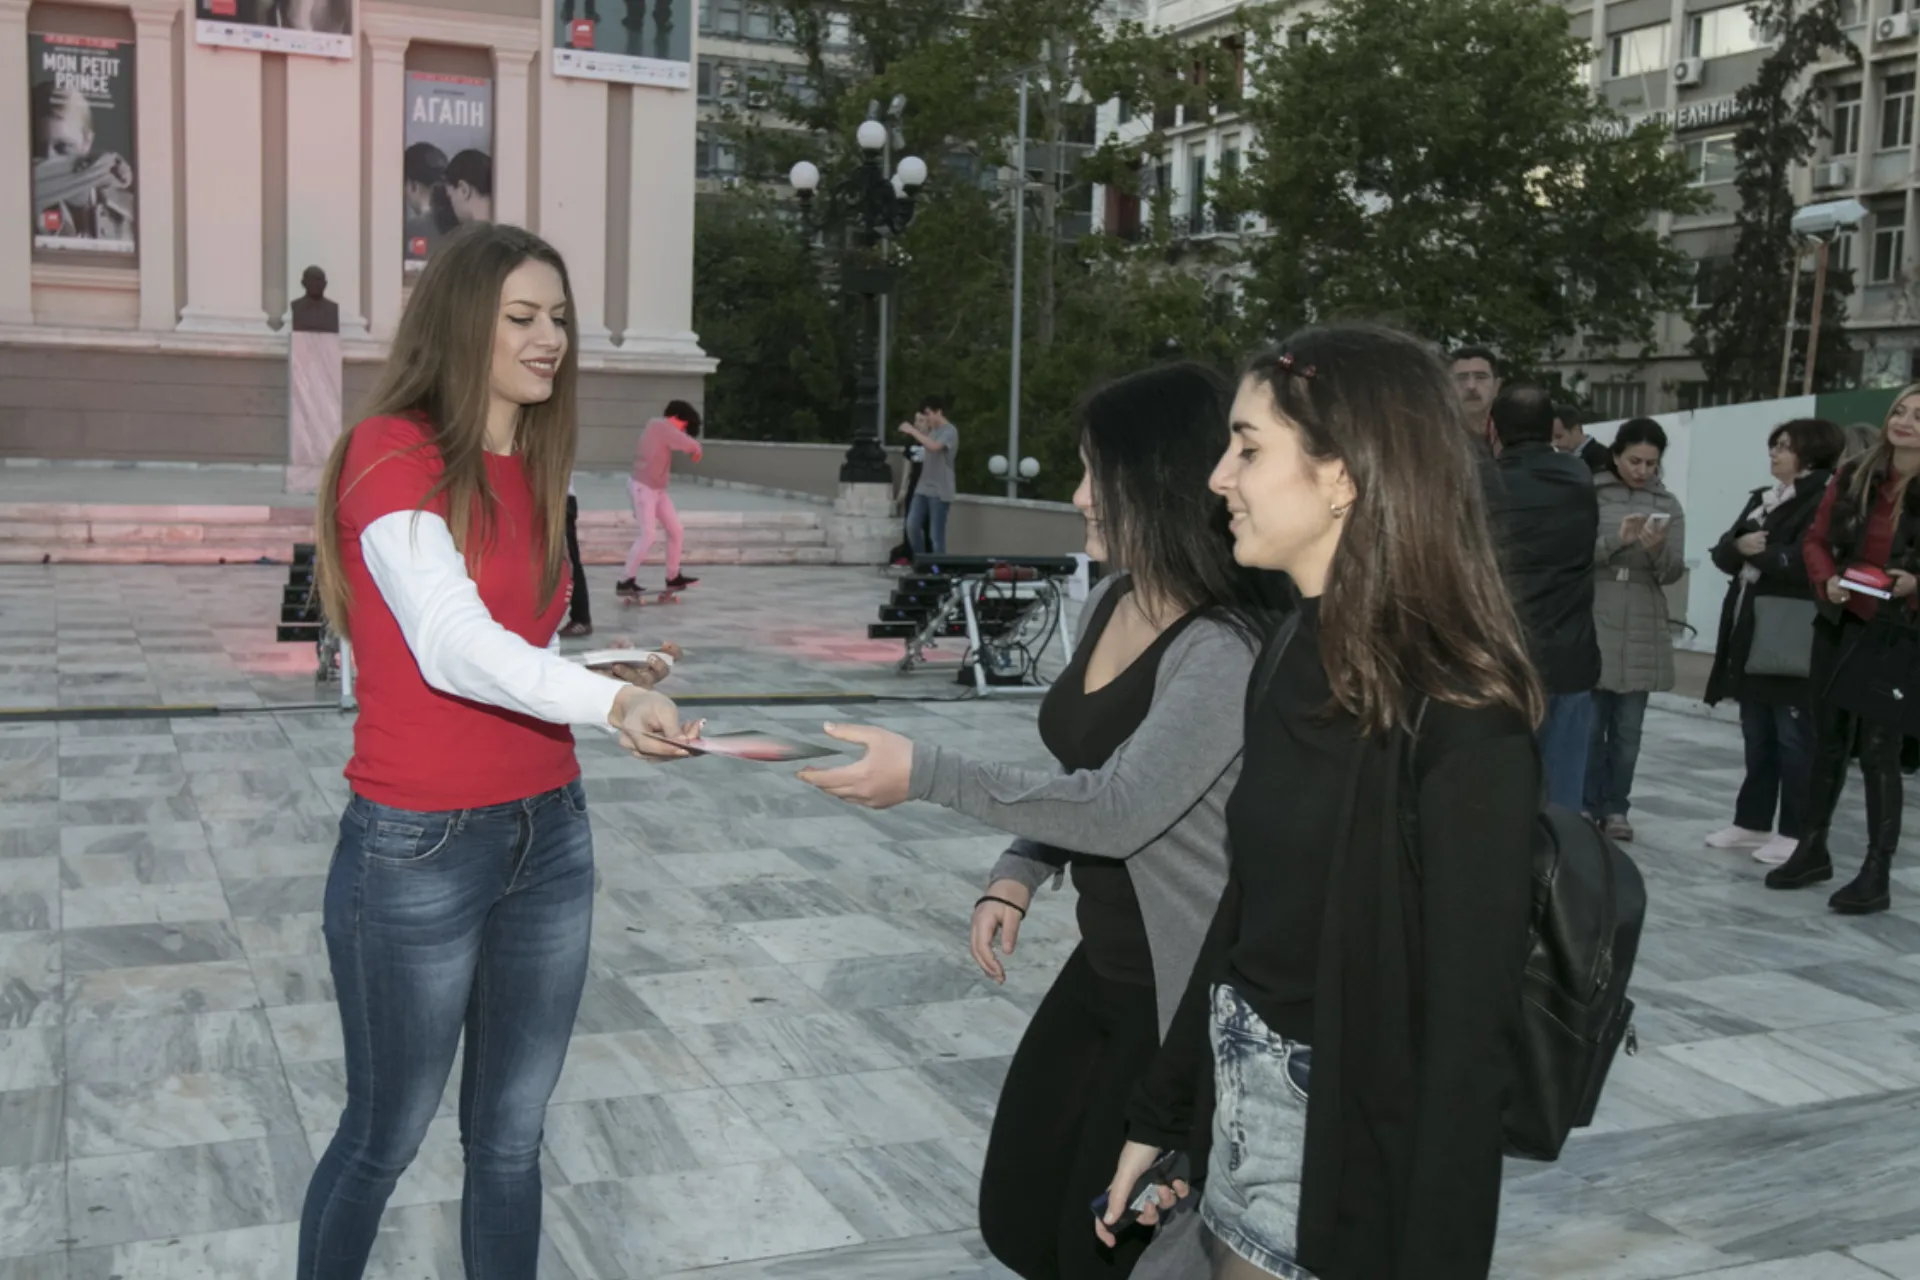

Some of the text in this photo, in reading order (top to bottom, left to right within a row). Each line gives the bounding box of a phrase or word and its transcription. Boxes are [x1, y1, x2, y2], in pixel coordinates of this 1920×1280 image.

[43, 52, 120, 77] MON PETIT
[55, 72, 109, 93] PRINCE
[412, 95, 484, 128] ΑΓΑΠΗ
